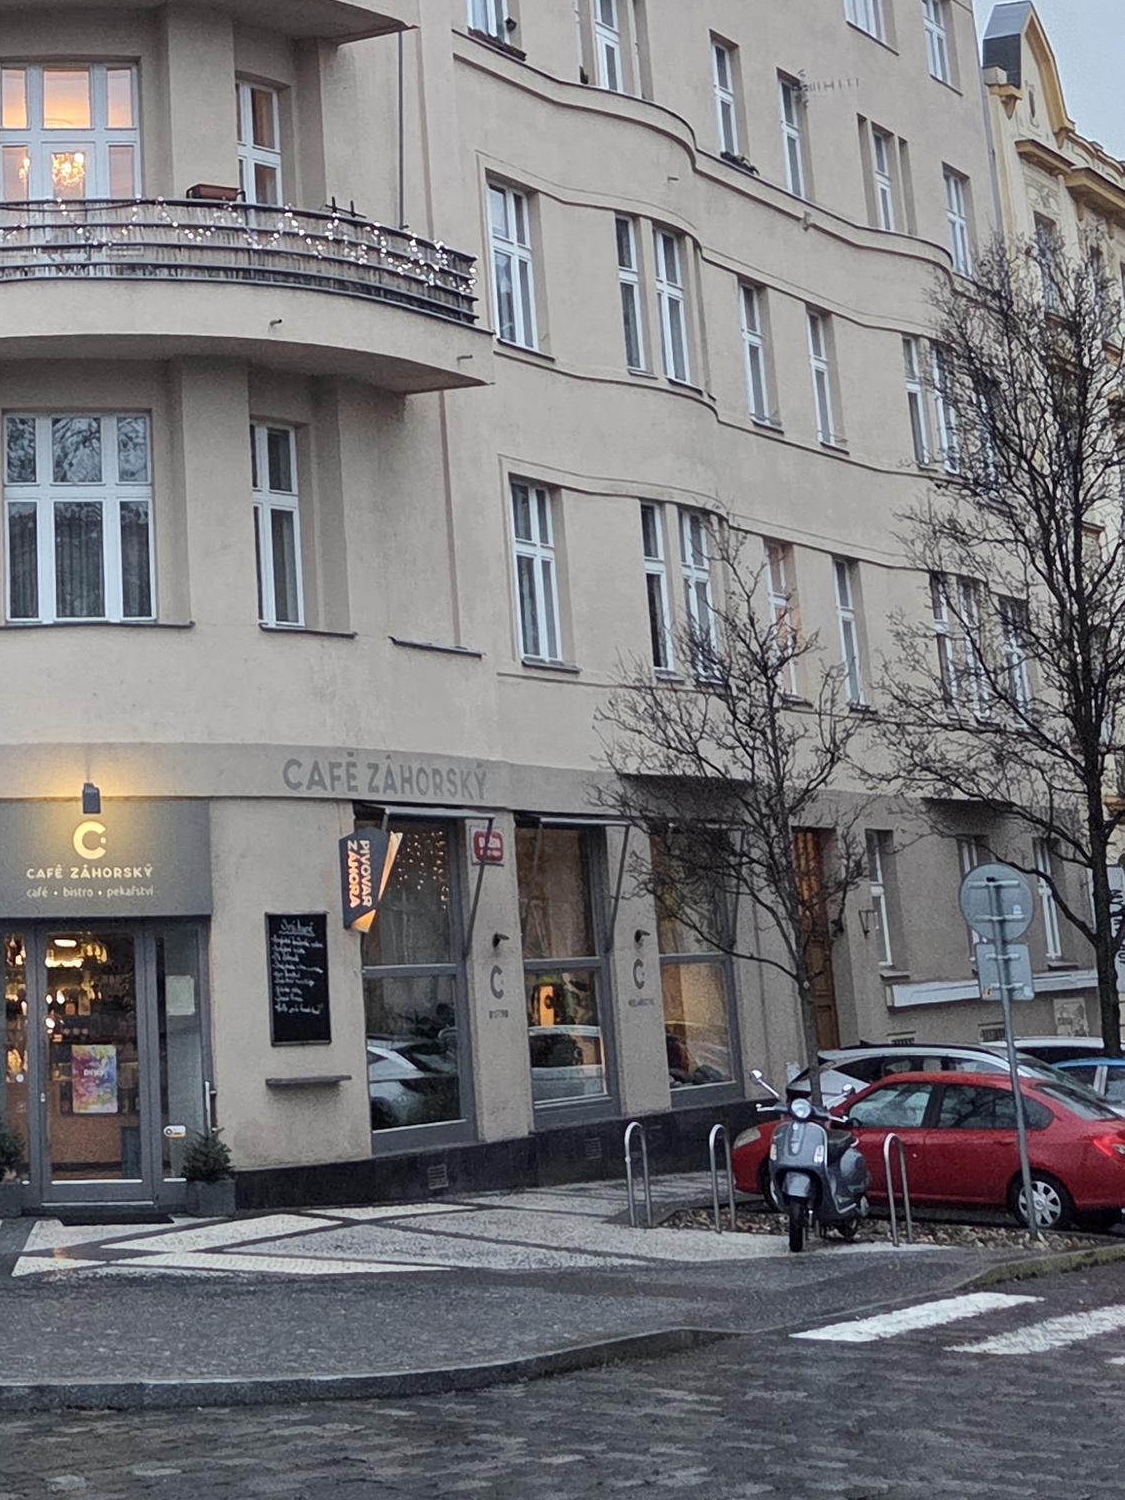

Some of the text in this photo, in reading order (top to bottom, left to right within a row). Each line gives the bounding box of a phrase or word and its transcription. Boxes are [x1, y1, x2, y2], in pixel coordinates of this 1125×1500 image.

[282, 751, 487, 800] CAFÉ ZÁHORSKÝ
[26, 863, 154, 879] CAFÉ ZÁHORSKÝ
[26, 885, 49, 898] café
[63, 885, 94, 898] bistro
[347, 839, 362, 908] ZÁHORA
[359, 839, 373, 907] PIVOVAR
